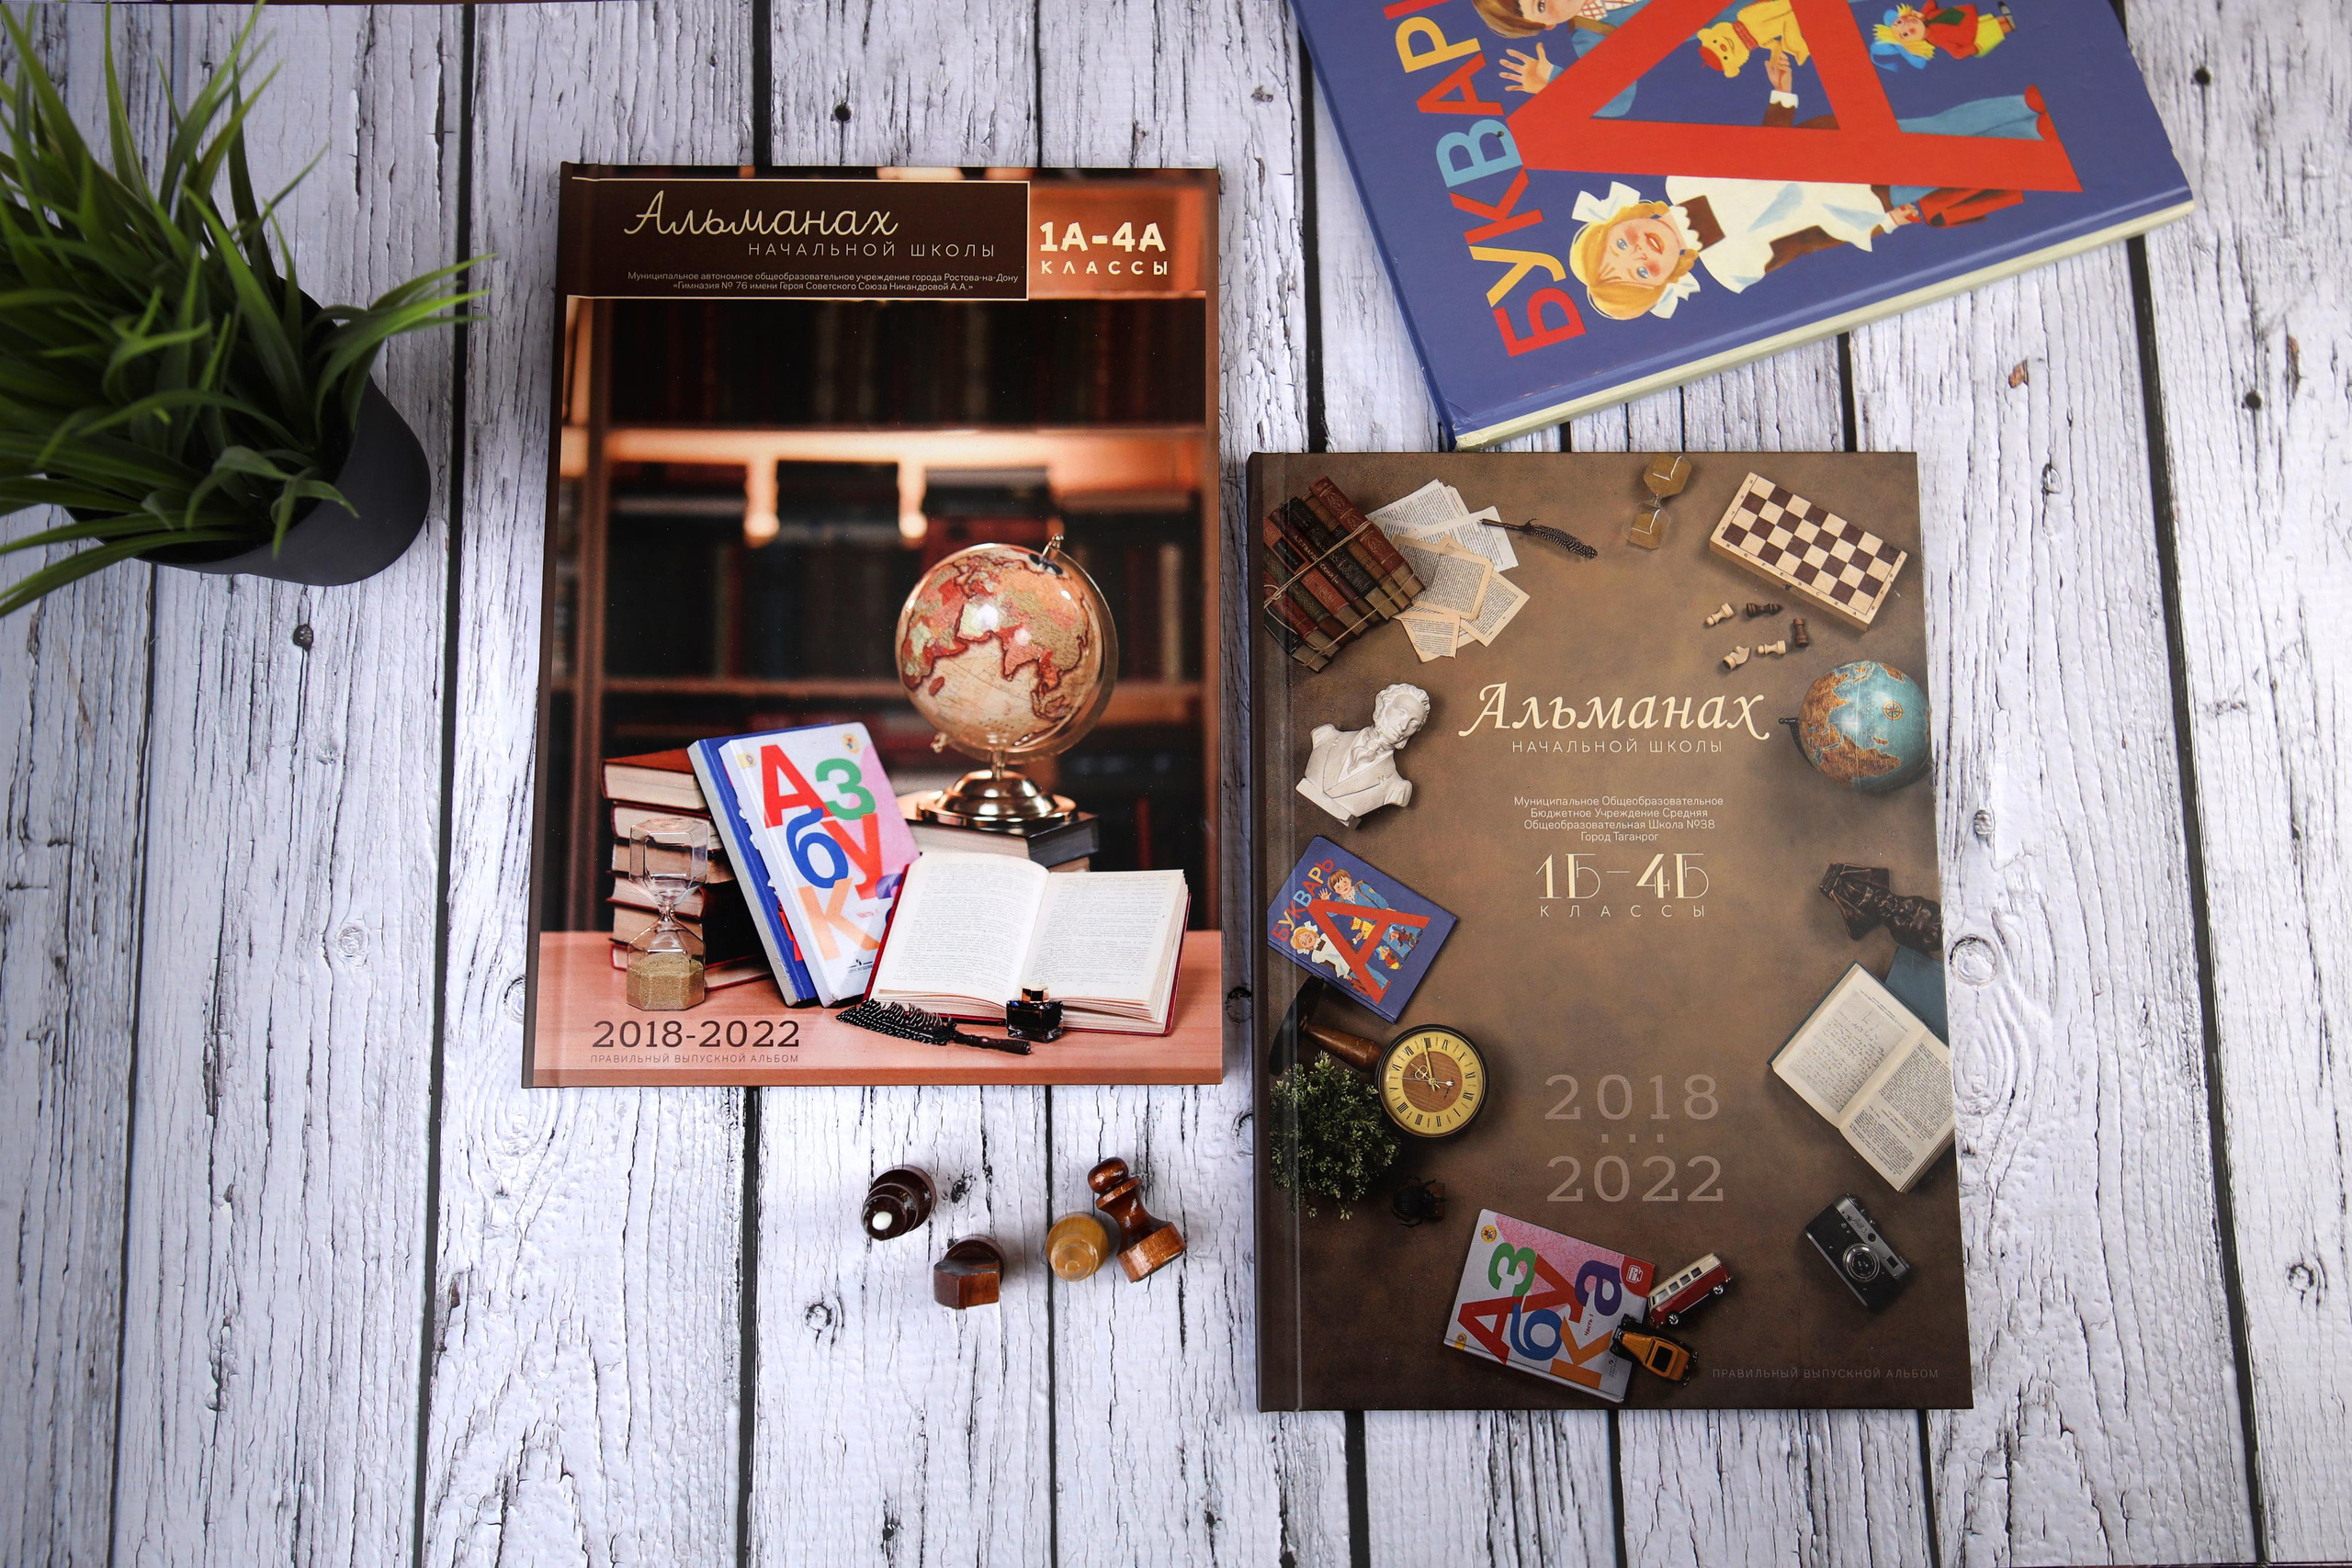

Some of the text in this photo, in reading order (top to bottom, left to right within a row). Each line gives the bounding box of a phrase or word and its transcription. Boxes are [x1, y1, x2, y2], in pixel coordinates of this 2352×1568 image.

[623, 189, 899, 236] Альманах
[1039, 221, 1167, 253] 1А-4А
[748, 241, 996, 258] НАЧАЛЬНОЙ ШКОЛЫ
[1040, 260, 1168, 276] КЛАССЫ
[628, 271, 1019, 284] Муниципальное автономное общеобразовательное учреждение города Ростова-на-Дону
[673, 281, 720, 289] «Гимназия
[735, 281, 748, 290] 76
[779, 282, 804, 291] Героя
[805, 282, 856, 291] Советского
[857, 282, 888, 291] Союза
[888, 282, 949, 292] Никандровой
[1458, 681, 1770, 741] Альманах
[1511, 738, 1723, 753] НАЧАЛЬНОЙ ШКОЛЫ
[1514, 796, 1724, 808] Муниципальное Общеобразовательное
[1531, 808, 1709, 818] Бюджетное Учреждение Средняя
[1523, 819, 1716, 831] Общеобразовательная Школа №38
[1580, 831, 1659, 843] Город Таганрог
[1271, 859, 1335, 942] БУКВАРЬ
[1540, 904, 1705, 919] КЛАССЫ
[592, 1020, 800, 1048] 2018-2022
[590, 1054, 799, 1064] ПРАВИЛЬНЫЙ ВЫПУСКНОЙ АЛЬБОМ
[1544, 1074, 1720, 1121] 2018
[1546, 1155, 1724, 1202] 2022
[1713, 1367, 1939, 1379] ПРАВИЛЬНЫЙ ВЫПУСКНОЙ АЛЬБОМ
